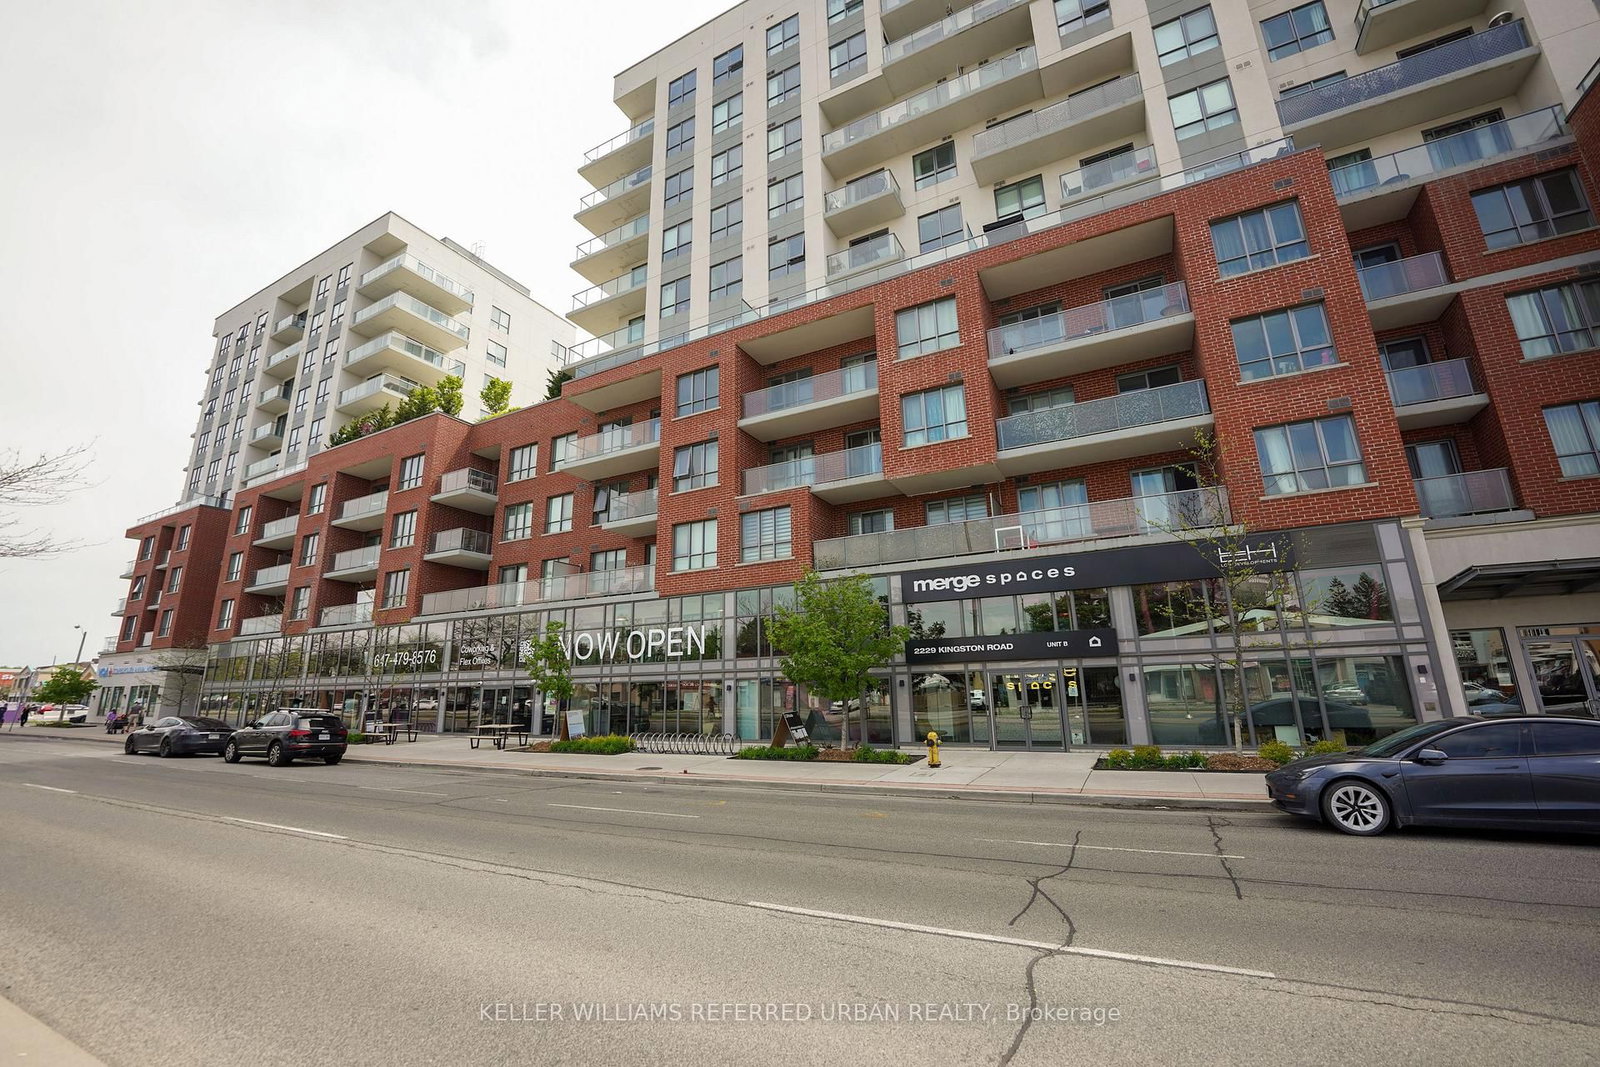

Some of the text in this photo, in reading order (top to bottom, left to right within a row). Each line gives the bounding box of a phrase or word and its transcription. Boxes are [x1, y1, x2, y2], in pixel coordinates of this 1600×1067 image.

[913, 574, 981, 592] merge
[558, 625, 705, 660] NOW OPEN
[913, 643, 1014, 654] 2229 KINGSTON ROAD
[374, 649, 436, 667] 647-479-8576
[459, 657, 472, 665] Flex
